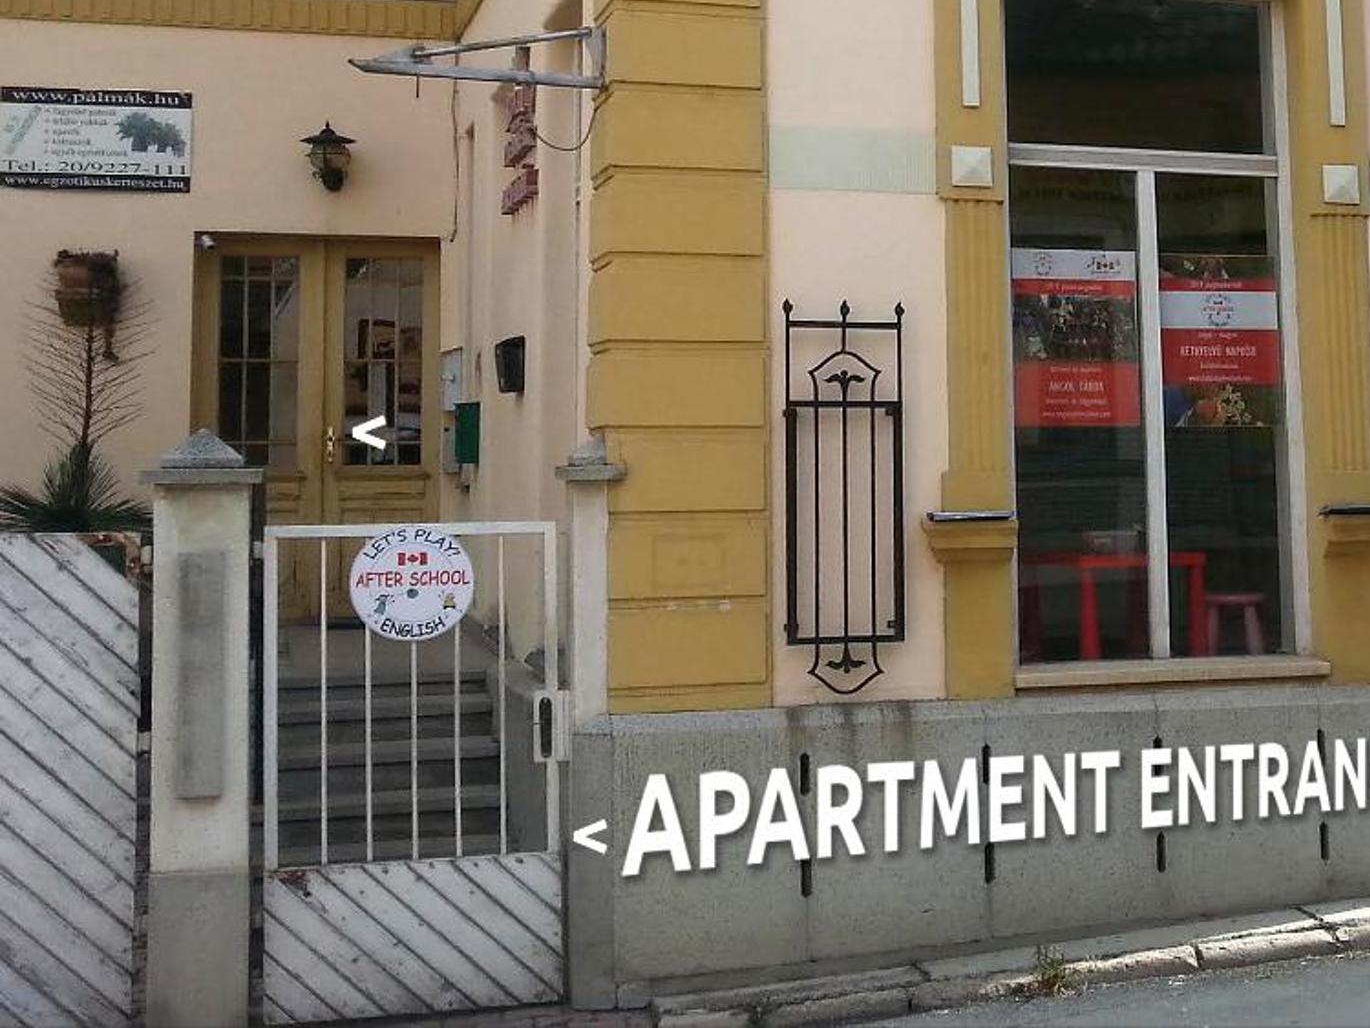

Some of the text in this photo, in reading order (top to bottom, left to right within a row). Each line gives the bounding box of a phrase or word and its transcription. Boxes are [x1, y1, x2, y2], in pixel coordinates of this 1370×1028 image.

[12, 89, 179, 105] www.pálmák.hu
[3, 159, 186, 175] Tel.: 20/9227-111
[363, 529, 462, 560] LET'S PLAY!
[356, 570, 470, 588] AFTER SCHOOL
[380, 616, 446, 638] ENGLISH
